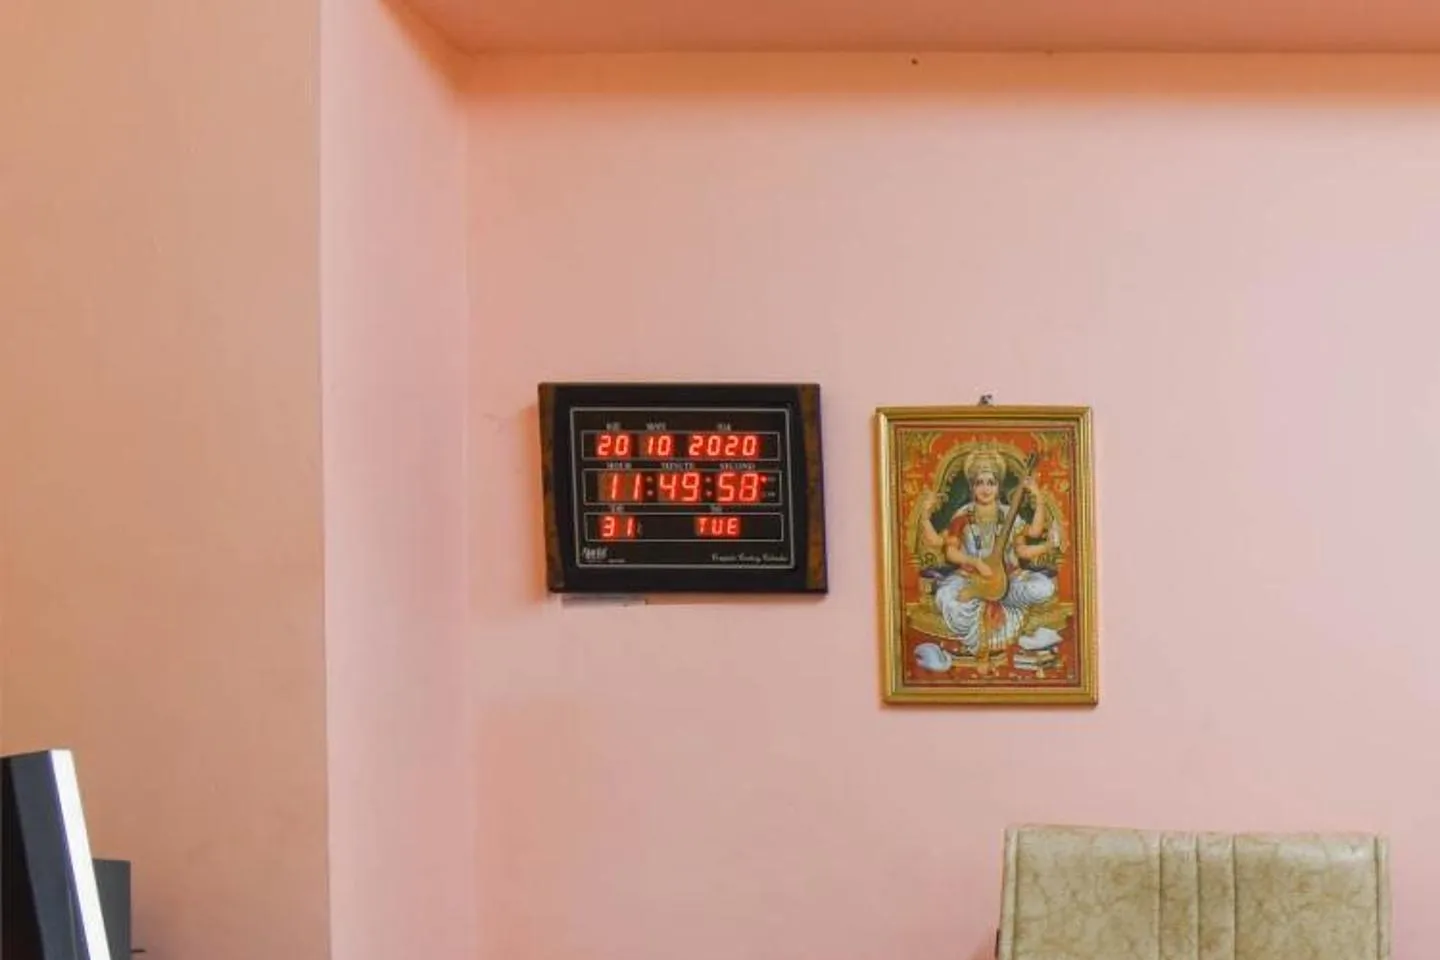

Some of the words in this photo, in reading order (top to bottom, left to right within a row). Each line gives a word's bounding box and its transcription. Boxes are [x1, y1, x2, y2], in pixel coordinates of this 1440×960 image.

[597, 434, 629, 456] 20
[645, 435, 672, 456] 10
[688, 435, 758, 456] 2020
[602, 517, 635, 537] 31
[698, 517, 740, 536] TUE
